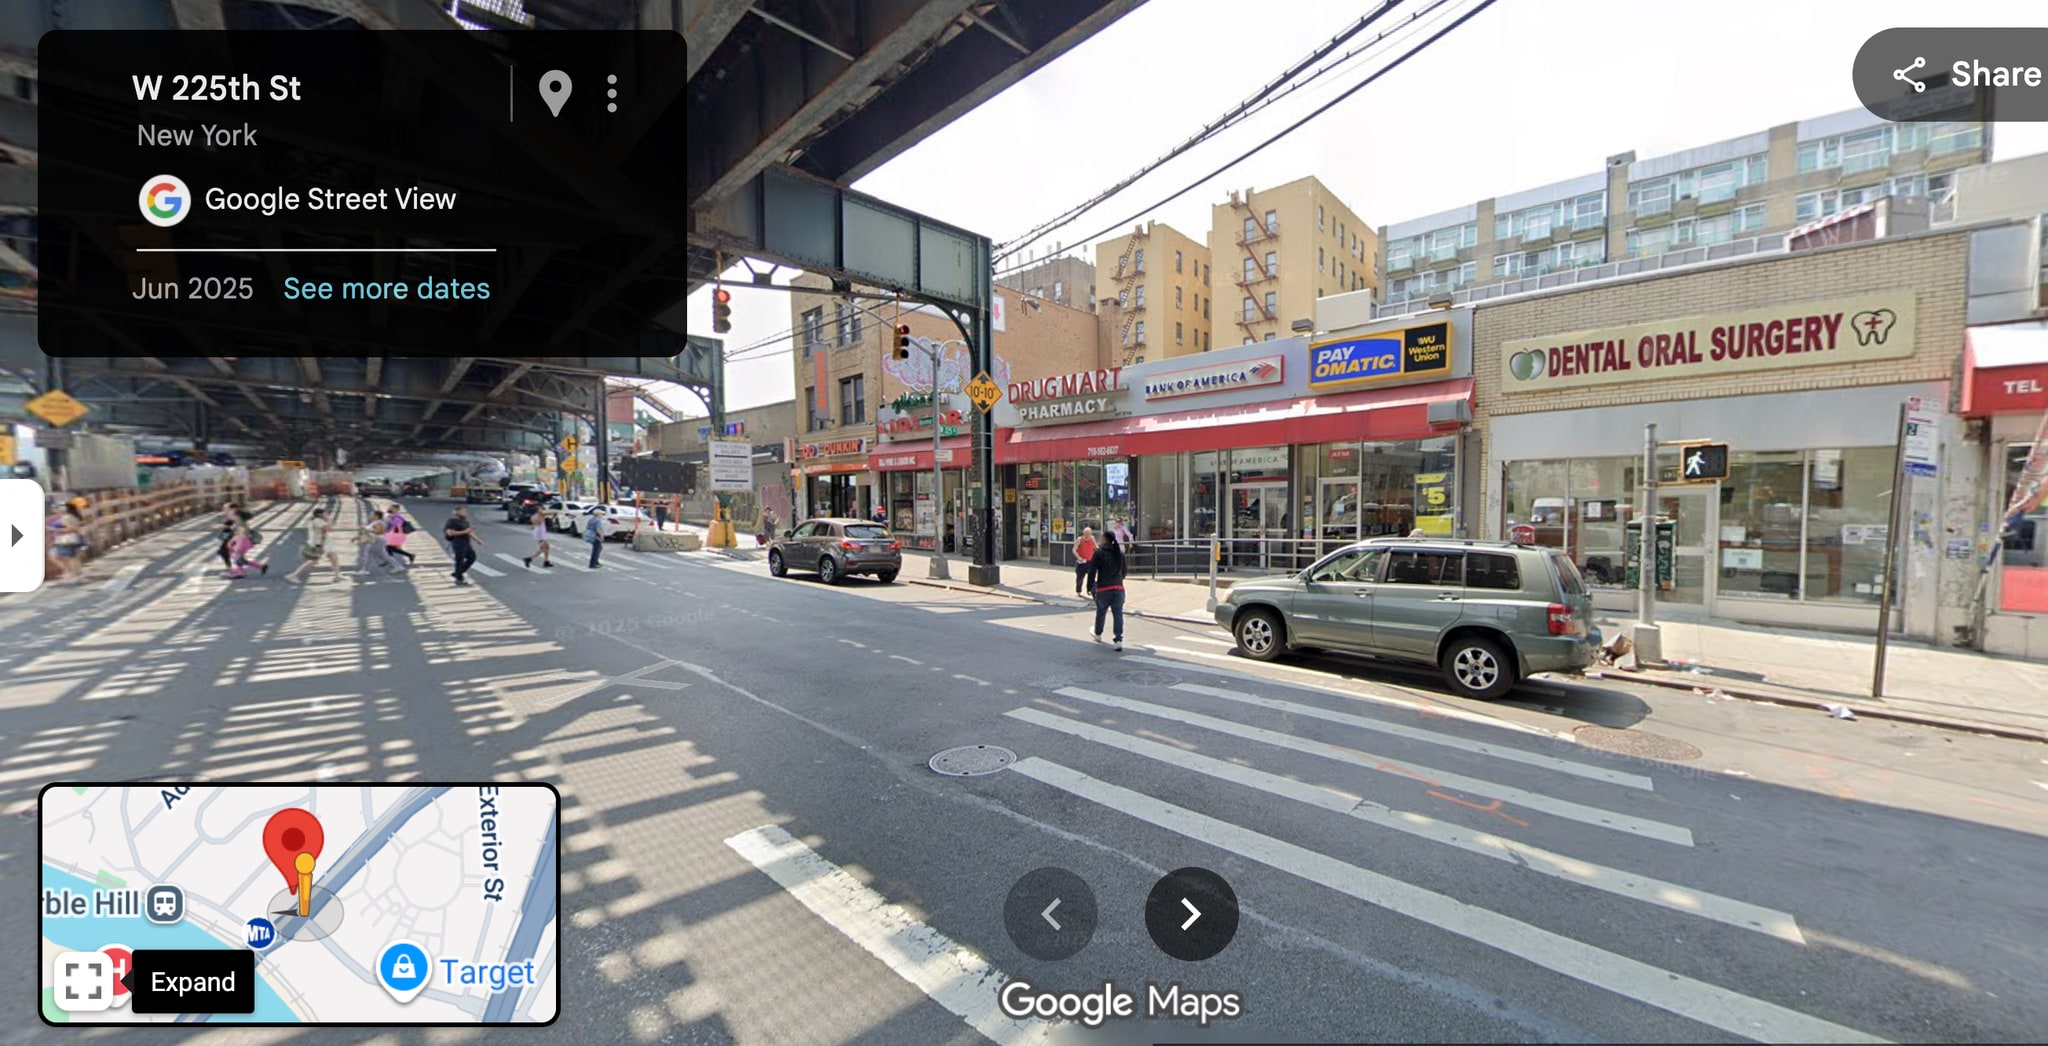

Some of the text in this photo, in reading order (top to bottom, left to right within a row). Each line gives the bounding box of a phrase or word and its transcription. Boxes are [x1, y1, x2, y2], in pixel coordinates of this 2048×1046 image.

[1417, 335, 1436, 346] WU
[1548, 313, 1844, 377] DENTAL ORAL SURGERY
[1317, 346, 1355, 364] PAY
[1408, 343, 1446, 355] Western
[1414, 352, 1440, 363] Union
[1315, 354, 1395, 378] OMATIC
[1008, 367, 1122, 404] DRUG MART
[1145, 372, 1247, 395] BANK OF AMERICA
[2003, 379, 2043, 394] TEL
[1019, 398, 1107, 420] PHARMACY
[823, 439, 863, 455] DUNKIN'
[1331, 450, 1350, 458] ATM
[1240, 456, 1279, 465] AMERICA
